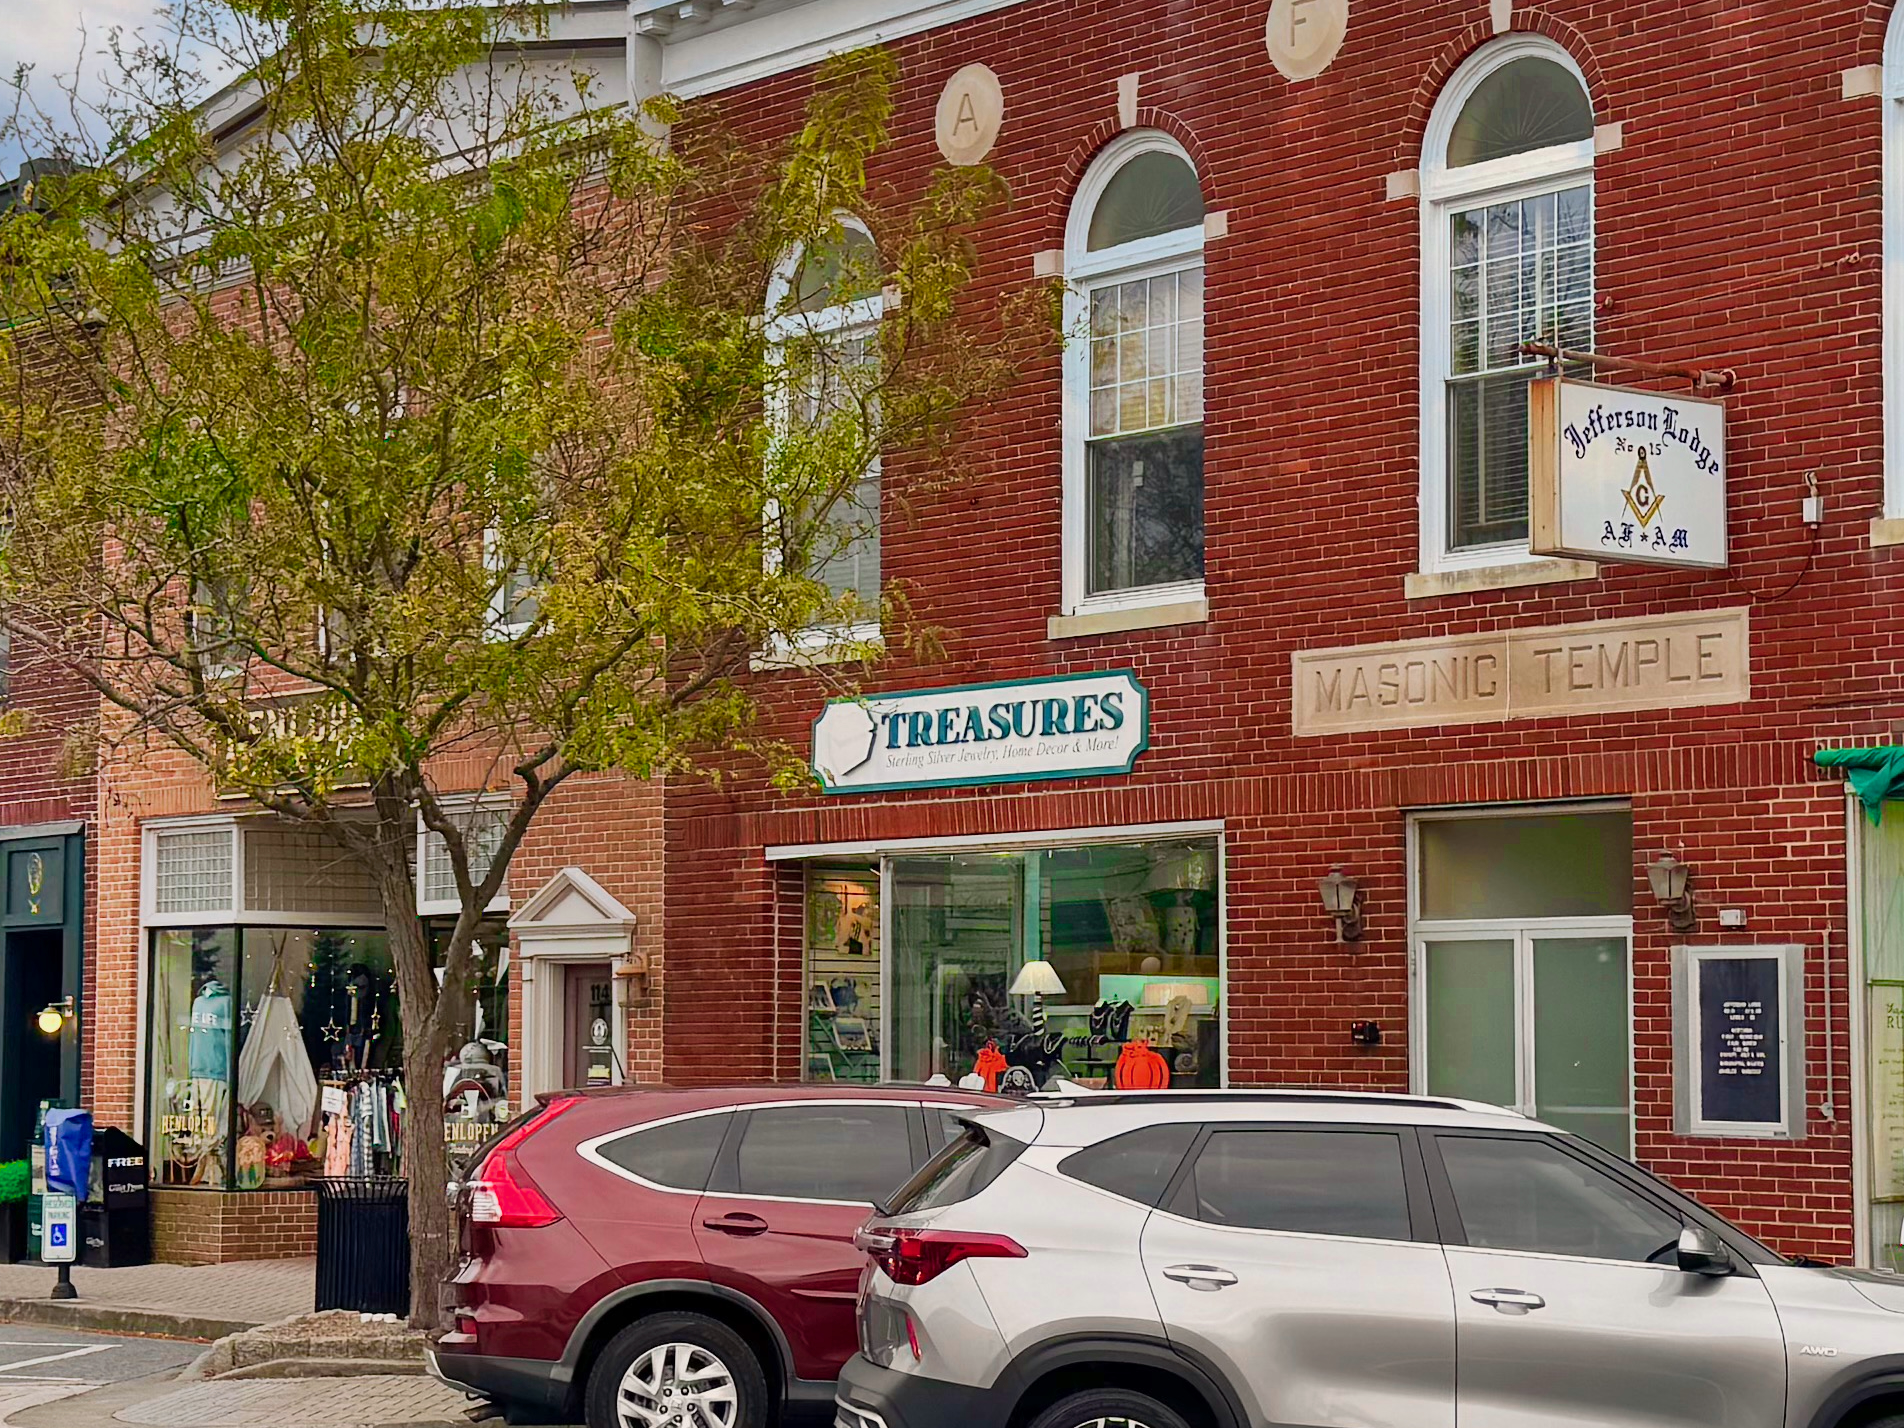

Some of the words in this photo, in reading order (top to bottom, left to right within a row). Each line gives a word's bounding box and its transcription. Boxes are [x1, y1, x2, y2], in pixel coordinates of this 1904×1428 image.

[952, 93, 978, 135] A
[1564, 404, 1658, 459] Jefferson
[1662, 406, 1719, 475] Lodge
[1649, 442, 1662, 456] 15
[1635, 484, 1649, 507] G
[1315, 654, 1497, 713] MASONIC
[1534, 632, 1723, 694] TEMPLE
[881, 691, 1124, 749] TREASURES
[886, 752, 924, 769] Sterling
[927, 748, 955, 764] Silver
[957, 745, 999, 764] Jewelry,
[1002, 743, 1034, 759] Home
[1036, 740, 1068, 756] Decor
[1071, 738, 1082, 753] &
[1085, 734, 1119, 751] More!
[591, 984, 609, 1001] 114
[161, 1115, 216, 1135] HENLOPEN
[444, 1122, 498, 1142] ENLOPE
[108, 1156, 144, 1167] FREE
[1800, 1346, 1838, 1357] AWD
